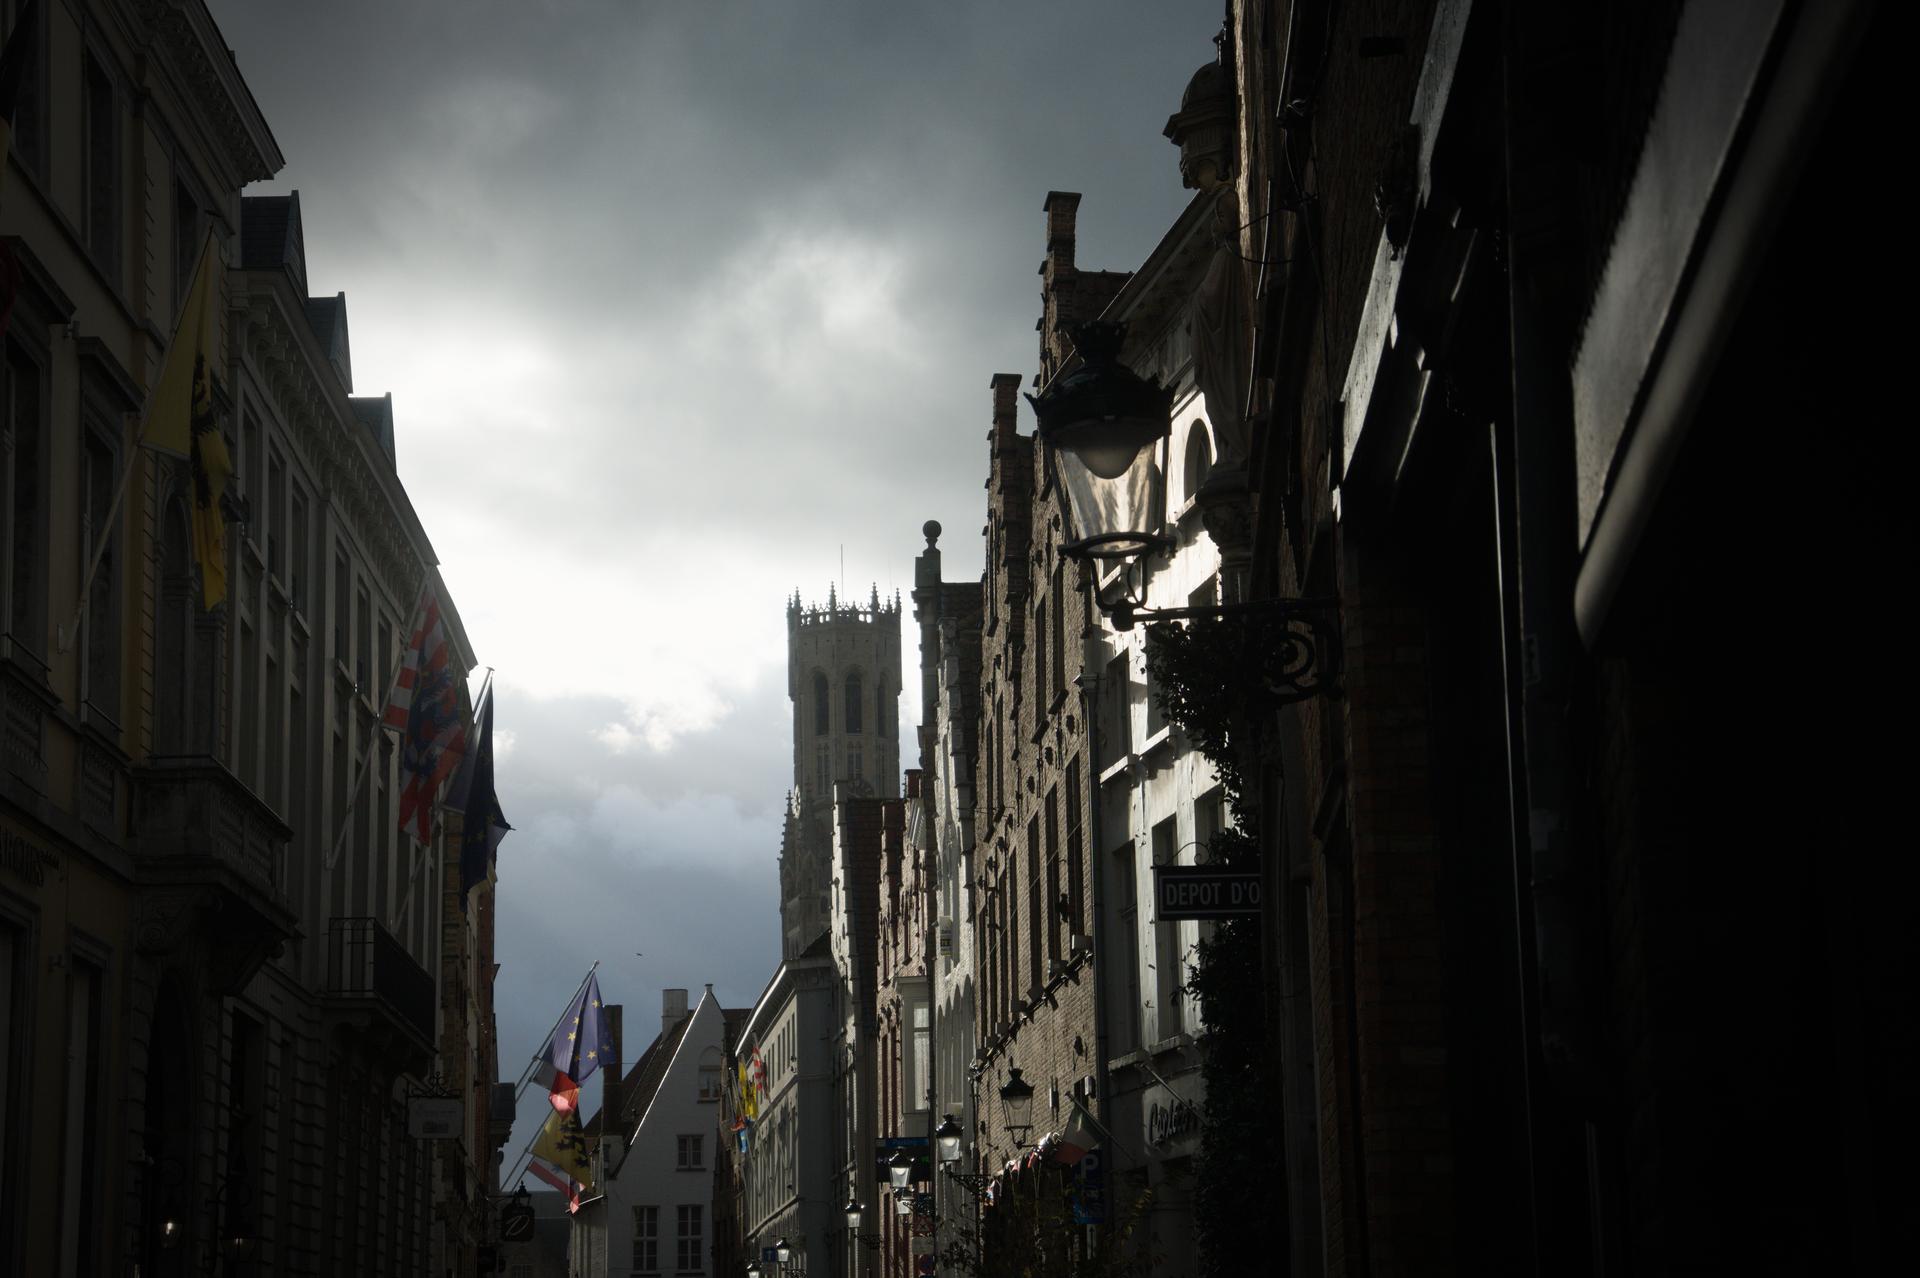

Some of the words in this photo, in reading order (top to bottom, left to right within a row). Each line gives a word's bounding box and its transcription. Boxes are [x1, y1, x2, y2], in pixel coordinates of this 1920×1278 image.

[1165, 881, 1222, 906] DEPOT
[1231, 880, 1260, 905] D'O
[1081, 1153, 1098, 1179] P
